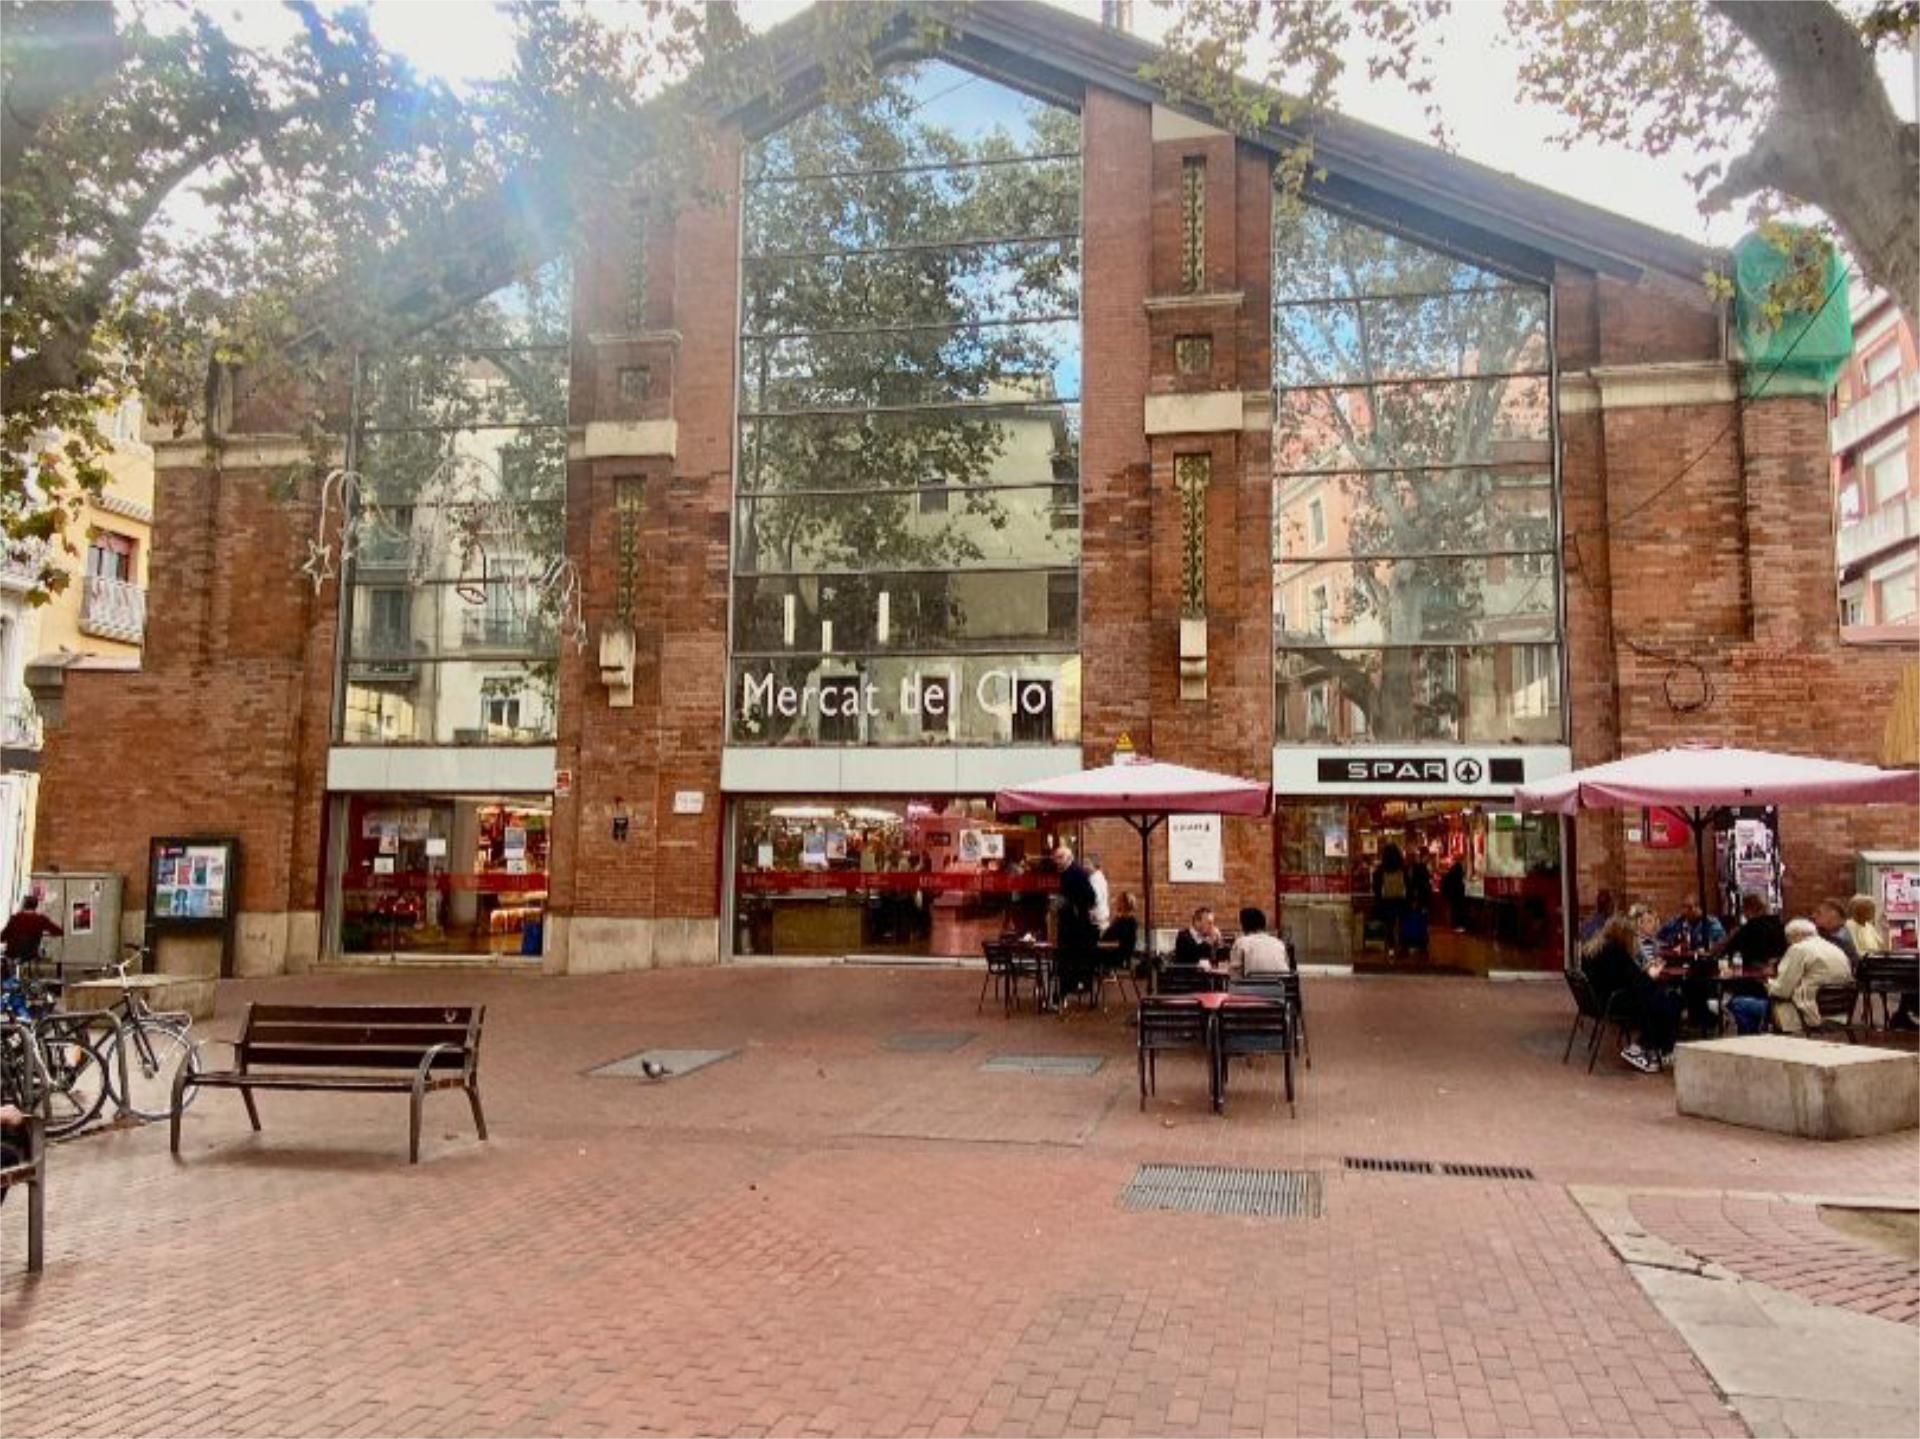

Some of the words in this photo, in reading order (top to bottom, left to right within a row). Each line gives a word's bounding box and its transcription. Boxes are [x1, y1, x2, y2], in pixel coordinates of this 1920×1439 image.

[743, 671, 881, 717] Mercat
[901, 671, 956, 715] del
[976, 669, 1055, 715] Clo
[1347, 761, 1446, 779] SPAR
